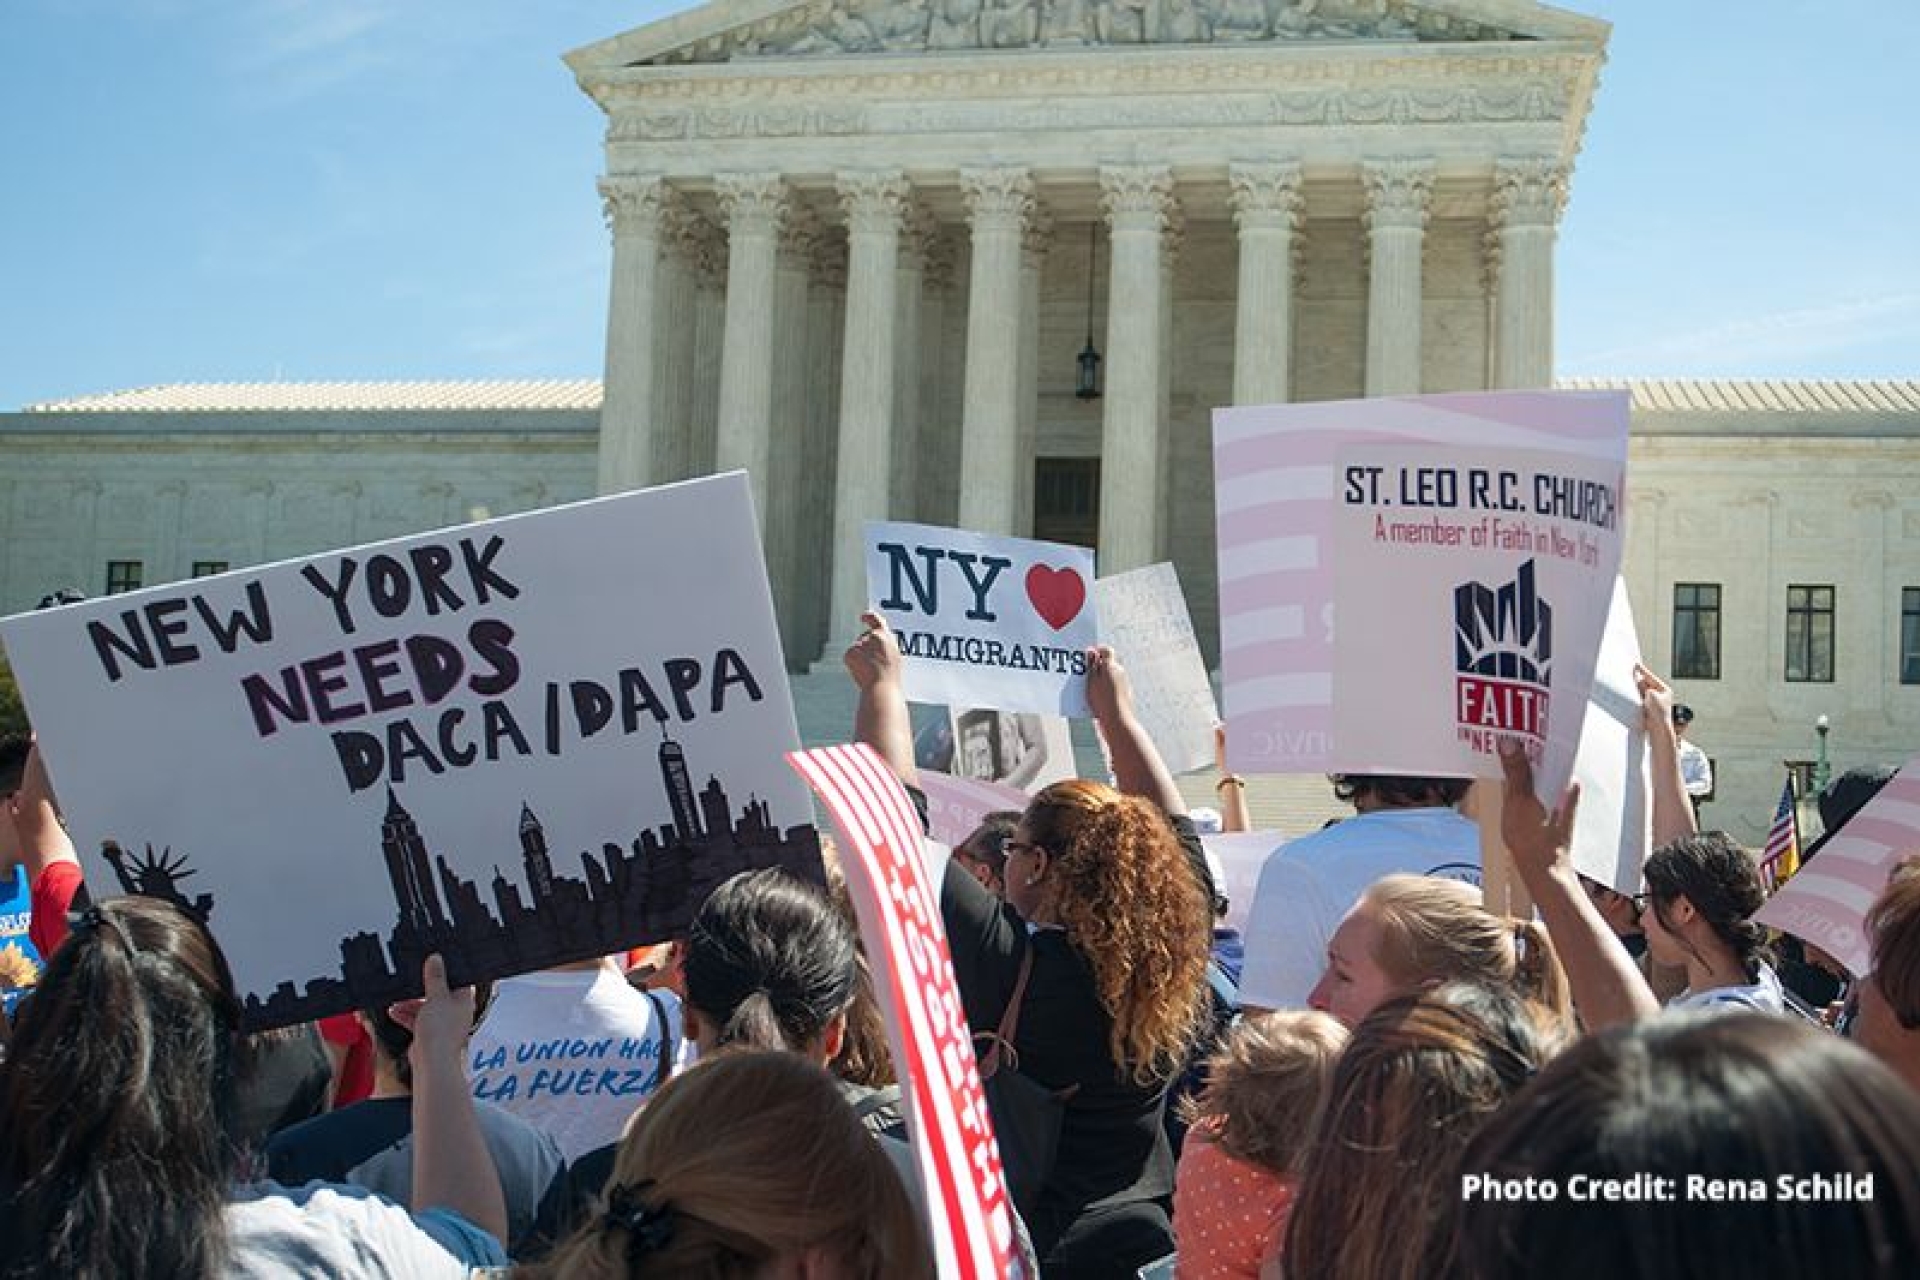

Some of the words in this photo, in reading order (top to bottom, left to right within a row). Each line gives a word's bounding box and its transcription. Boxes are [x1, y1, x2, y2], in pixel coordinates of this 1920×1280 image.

[1345, 465, 1391, 505] ST.
[1400, 467, 1458, 508] LEO
[1469, 470, 1526, 512] R.C.
[1534, 473, 1616, 532] CHURCH
[1373, 513, 1387, 541] A
[1390, 516, 1465, 546] member
[1471, 517, 1488, 548] of
[1493, 518, 1533, 551] Faith
[86, 580, 273, 682] NEW
[300, 535, 520, 634] YORK
[877, 542, 1012, 622] NY
[241, 619, 521, 738] NEEDS
[892, 629, 1087, 676] MMIGRANTS
[1461, 682, 1549, 735] FAITH
[473, 1045, 507, 1072] LA
[515, 1037, 612, 1063] UNION
[473, 1073, 517, 1101] LA
